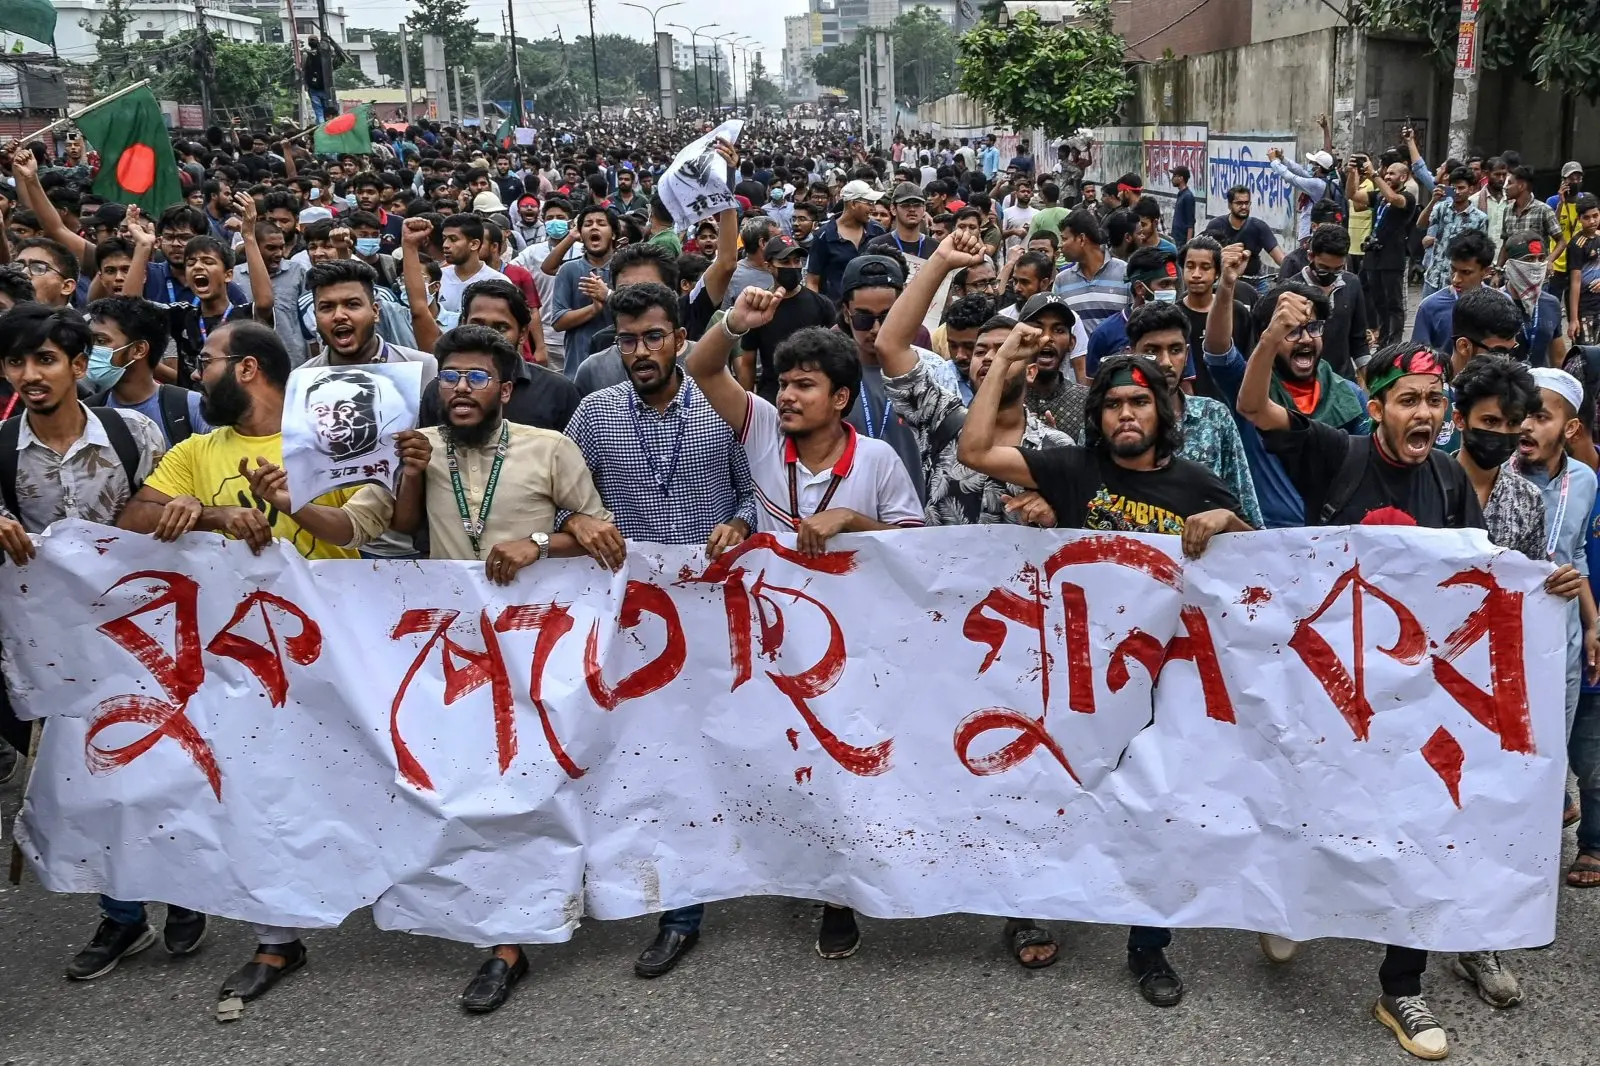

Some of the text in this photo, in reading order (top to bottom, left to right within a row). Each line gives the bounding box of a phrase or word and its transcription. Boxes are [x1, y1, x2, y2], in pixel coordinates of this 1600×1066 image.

[480, 460, 501, 518] HIKMA MADRASA
[85, 568, 322, 803] বুক
[953, 534, 1237, 786] গুলি
[1288, 557, 1536, 807] কর
